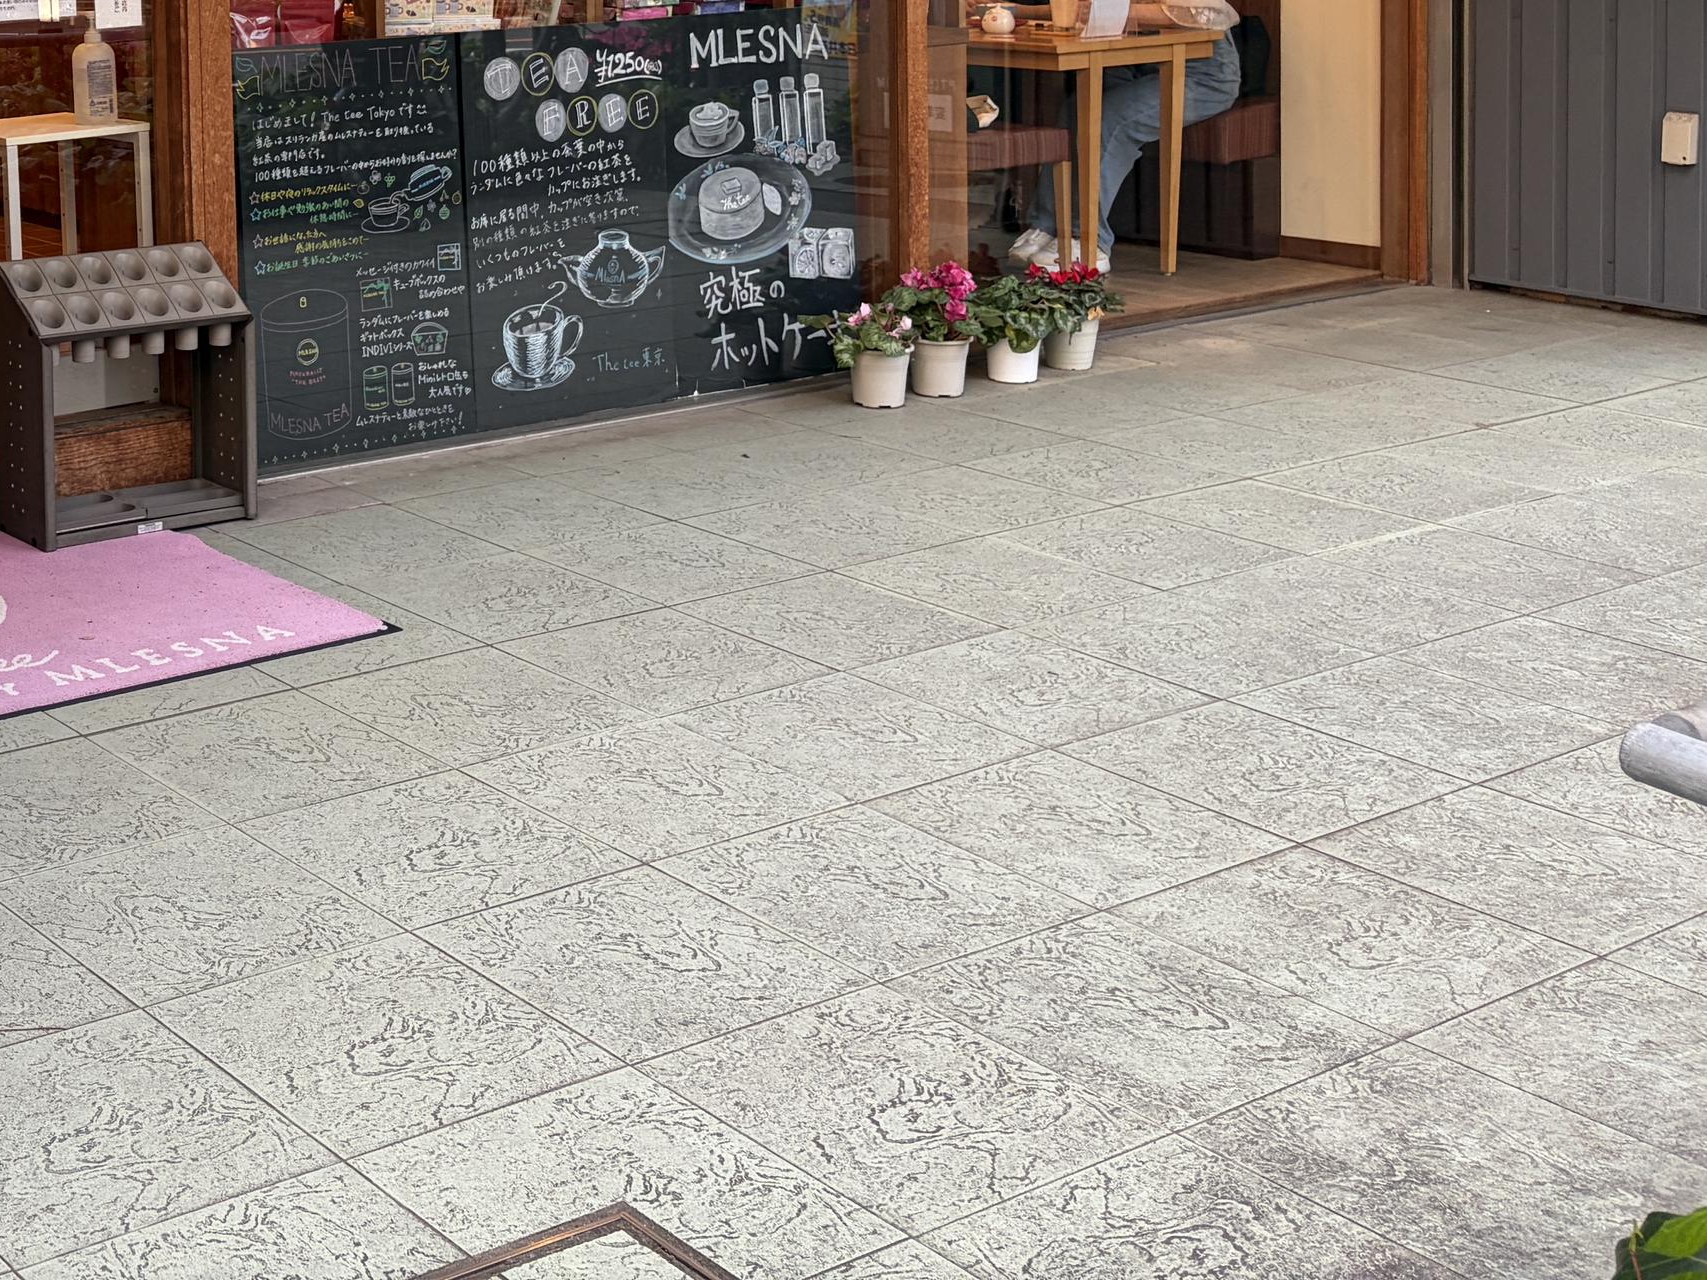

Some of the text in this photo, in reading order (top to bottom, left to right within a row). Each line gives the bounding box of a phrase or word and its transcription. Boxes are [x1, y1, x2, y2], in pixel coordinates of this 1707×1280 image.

[689, 23, 829, 70] MLESNA
[261, 44, 422, 96] MLESNA TEA
[321, 111, 340, 123] The
[344, 108, 363, 120] tee
[367, 106, 396, 122] Tokyo
[398, 104, 414, 119] です
[543, 95, 650, 136] FREE
[470, 153, 633, 196] ランダムに色々なフレーバーの紅茶を
[472, 137, 625, 177] 100種類以上の茶葉の中から
[700, 266, 785, 320] 究極の
[417, 359, 457, 372] おしゃれな
[594, 352, 619, 372] The
[270, 402, 350, 435] MLESNA TEA
[45, 619, 298, 688] MLESNA
